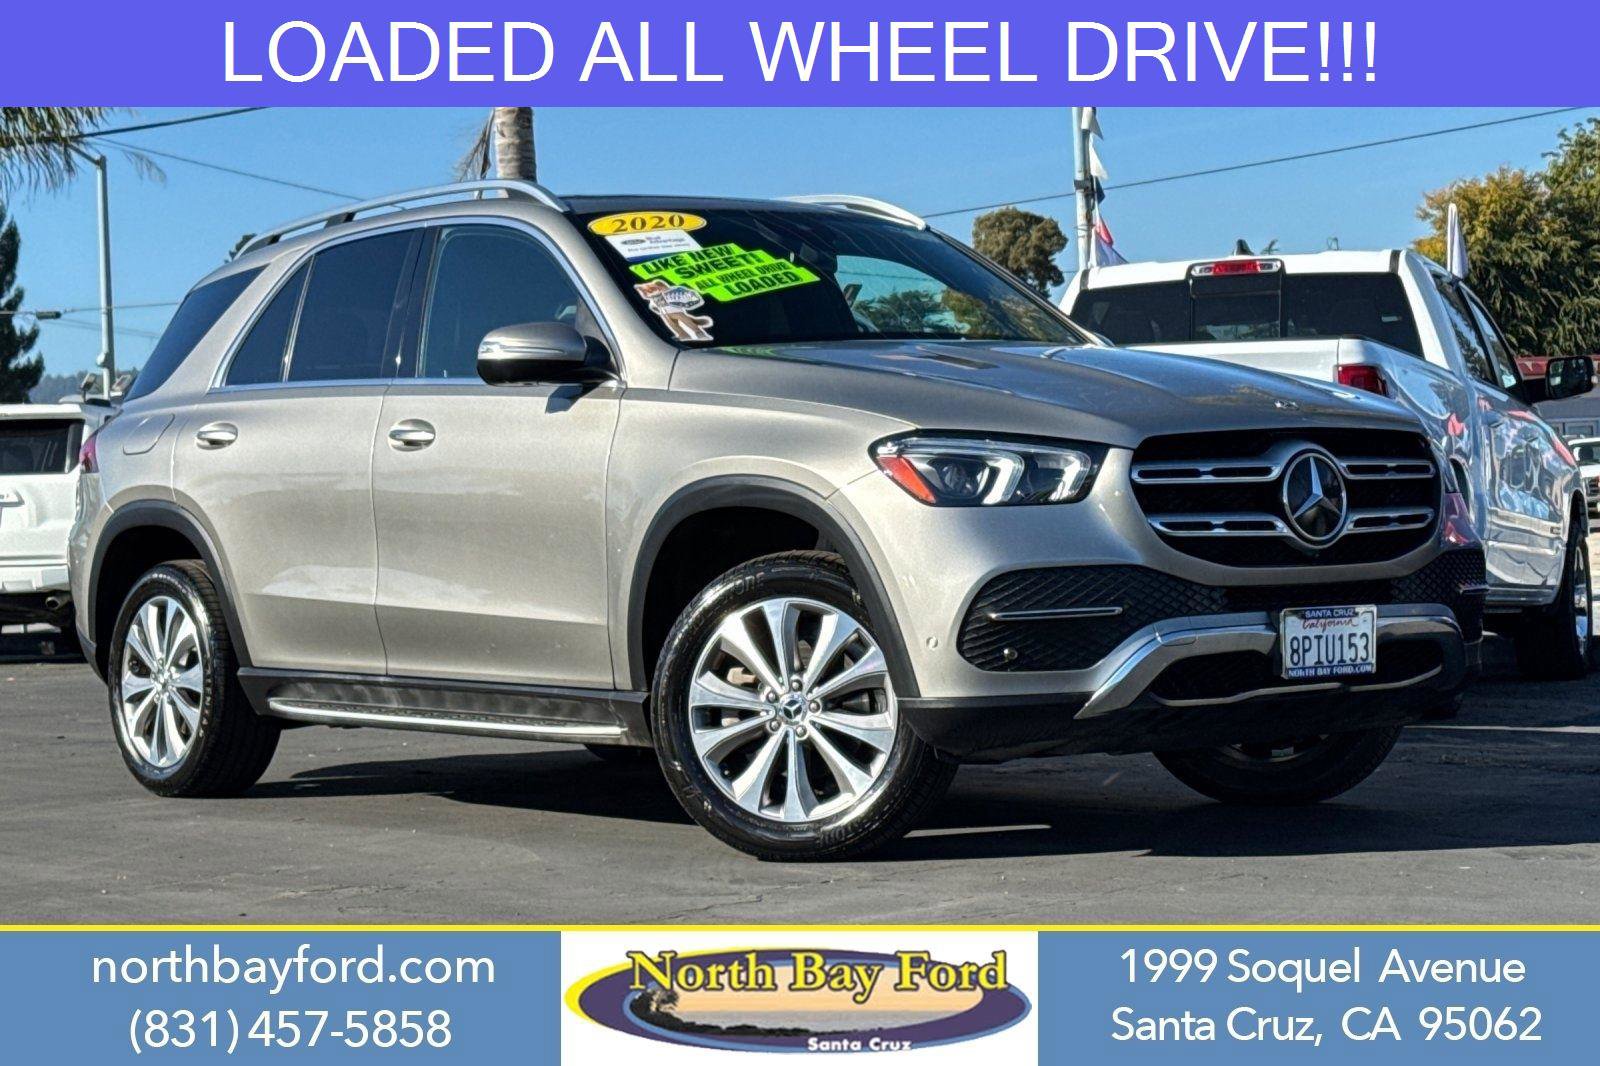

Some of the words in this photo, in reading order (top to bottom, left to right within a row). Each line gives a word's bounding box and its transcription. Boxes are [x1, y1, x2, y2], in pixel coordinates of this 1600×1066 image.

[611, 214, 685, 233] 2020
[640, 252, 687, 274] LIKE
[691, 245, 735, 262] NEW
[674, 252, 763, 280] SWEET!
[718, 267, 755, 283] WHEEL
[755, 261, 793, 275] DRIVE
[723, 270, 802, 296] LOADED
[1302, 618, 1359, 631] California
[1305, 609, 1332, 619] SANTA
[1333, 608, 1355, 617] CRUZ
[1289, 632, 1370, 667] 8PIU153
[1288, 667, 1315, 678] NORTH
[1317, 666, 1332, 676] BAY
[1333, 664, 1373, 675] FORD.COM
